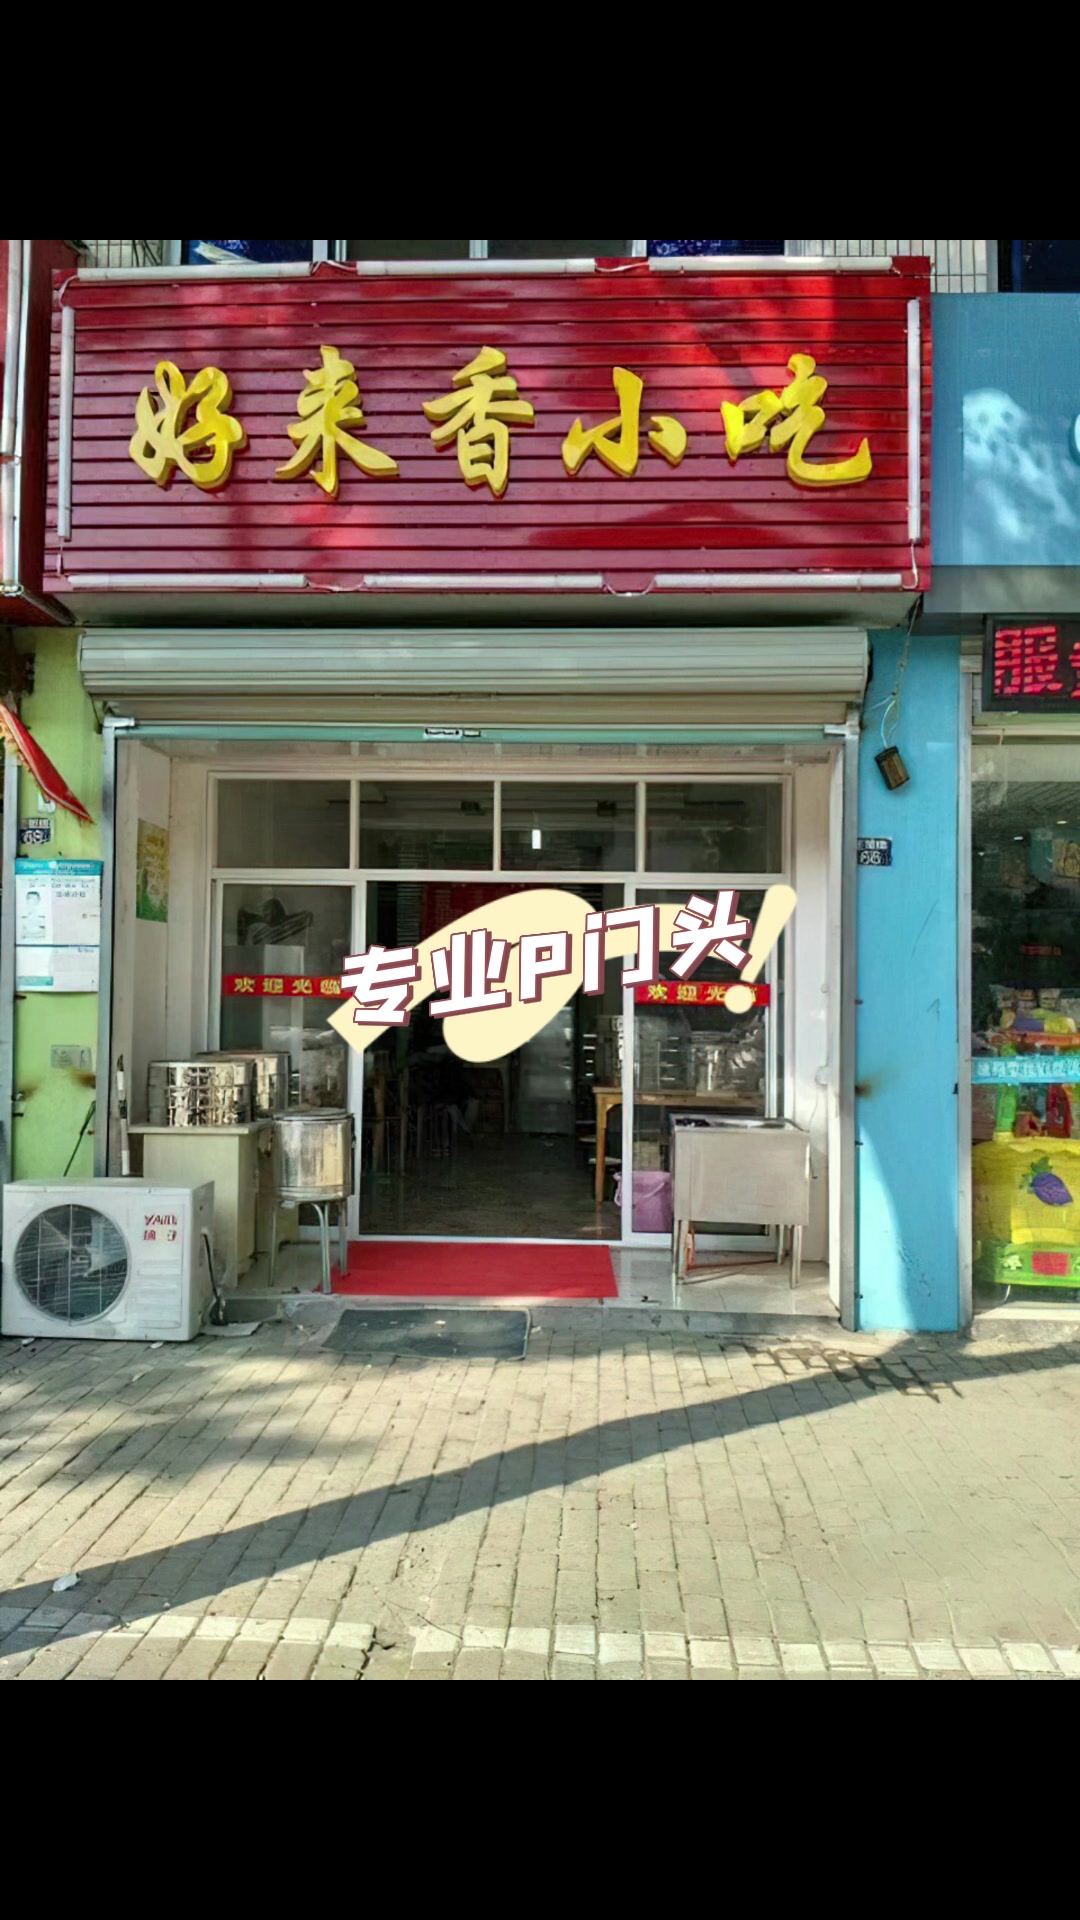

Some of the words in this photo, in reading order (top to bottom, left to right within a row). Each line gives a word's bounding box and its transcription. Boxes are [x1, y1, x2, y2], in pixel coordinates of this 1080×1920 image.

[129, 345, 873, 498] 好来香小吃
[234, 977, 341, 995] 欢迎光临
[648, 983, 757, 1003] 欢迎光
